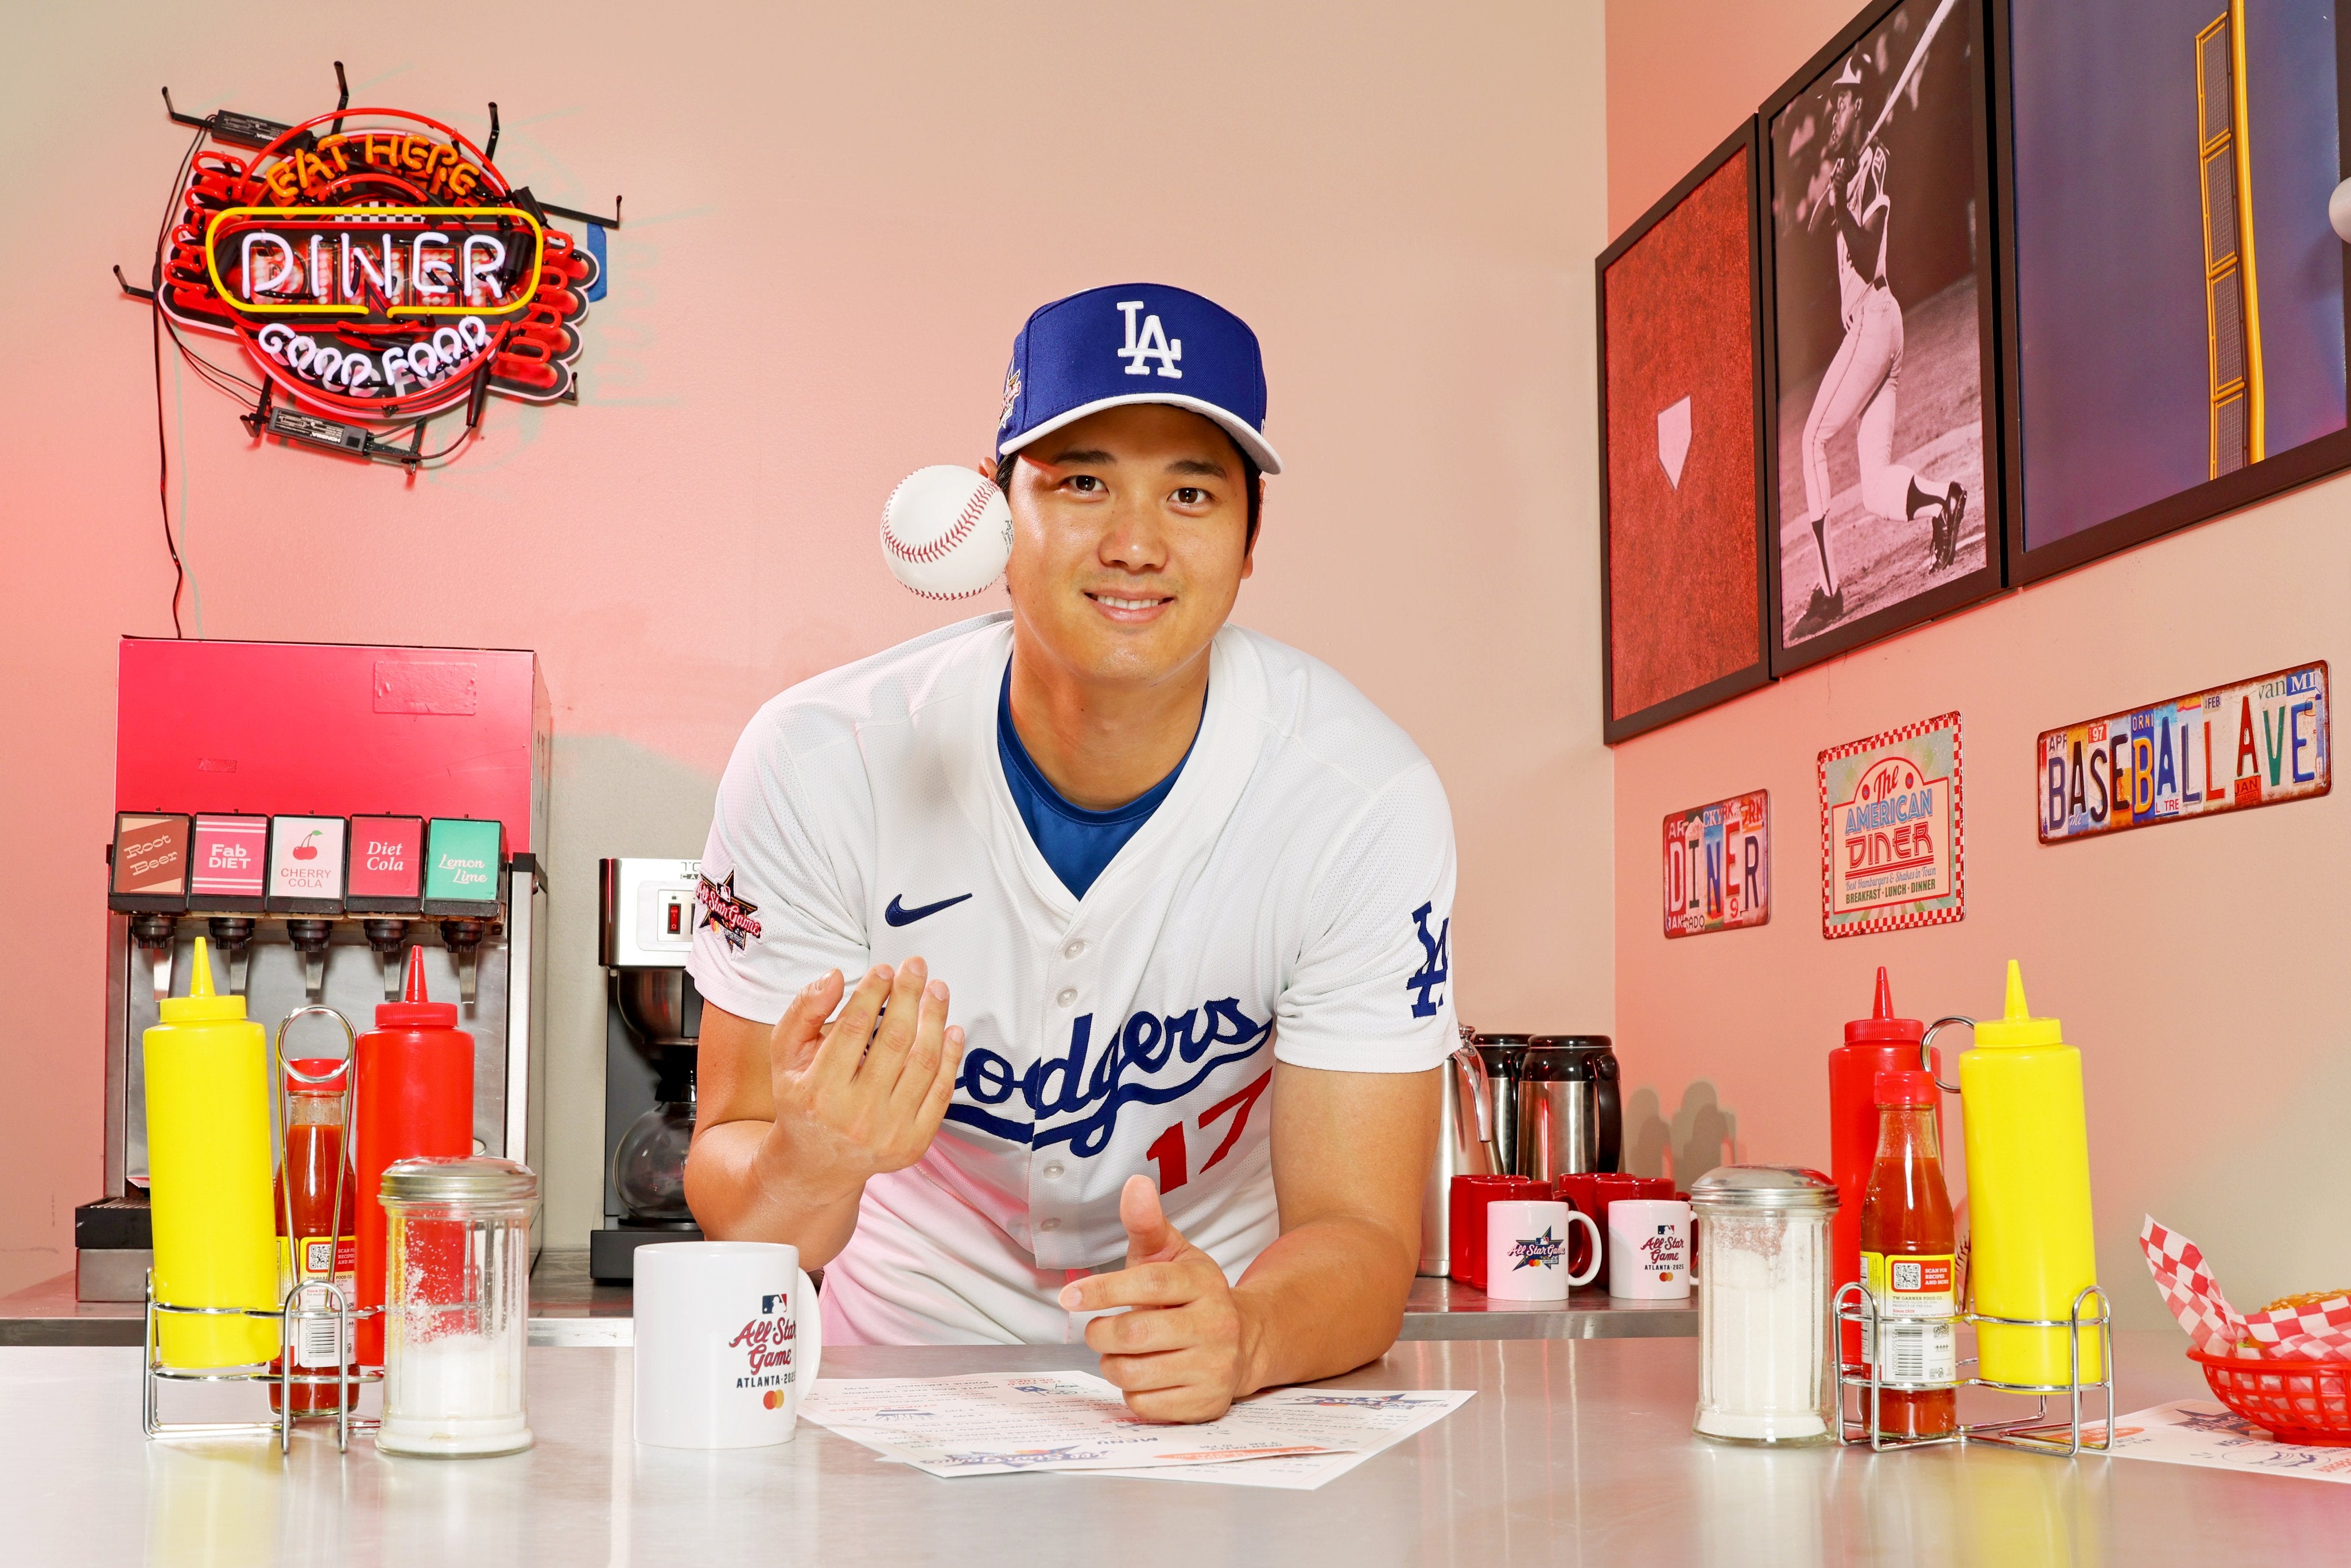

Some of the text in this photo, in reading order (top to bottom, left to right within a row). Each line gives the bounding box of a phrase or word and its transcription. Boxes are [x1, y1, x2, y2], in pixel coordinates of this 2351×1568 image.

[267, 133, 480, 199] EAT HERE
[242, 231, 506, 298] DINER
[259, 316, 486, 387] GOOD FOOD
[1116, 300, 1182, 379] LA
[2208, 696, 2221, 709] FEB
[2092, 726, 2104, 741] 97
[2049, 696, 2315, 831] BASEBALL AVE
[1874, 765, 1899, 804] The
[2235, 778, 2257, 795] JAN
[1845, 788, 1933, 835] AMERICAN
[123, 833, 172, 860] Root
[211, 844, 247, 858] Fab
[366, 841, 403, 857] Diet
[1845, 821, 1933, 869] DINER
[130, 851, 179, 876] Beer
[209, 856, 251, 870] DIET
[281, 868, 331, 879] CHERRY
[366, 856, 404, 872] Cola
[438, 853, 486, 870] Lemon
[1670, 821, 1759, 915] DINER
[288, 878, 323, 888] COLA
[452, 867, 487, 884] Lime
[1846, 880, 1856, 891] Best
[1857, 873, 1889, 890] Hamburgers
[1895, 868, 1915, 881] Shakes
[1915, 868, 1921, 877] in
[1921, 865, 1937, 876] Town
[1846, 879, 1936, 904] BREAKFAST LUNCH DINNER
[709, 891, 728, 920] Star
[728, 905, 762, 938] Game
[954, 996, 1273, 1158] odgers
[1147, 1066, 1273, 1195] 17
[1507, 1244, 1566, 1257] All Star Game
[1640, 1236, 1684, 1250] All Star
[1650, 1249, 1679, 1264] Game
[729, 1319, 772, 1348] All
[748, 1344, 792, 1376] Game
[736, 1375, 781, 1388] ATLANTA
